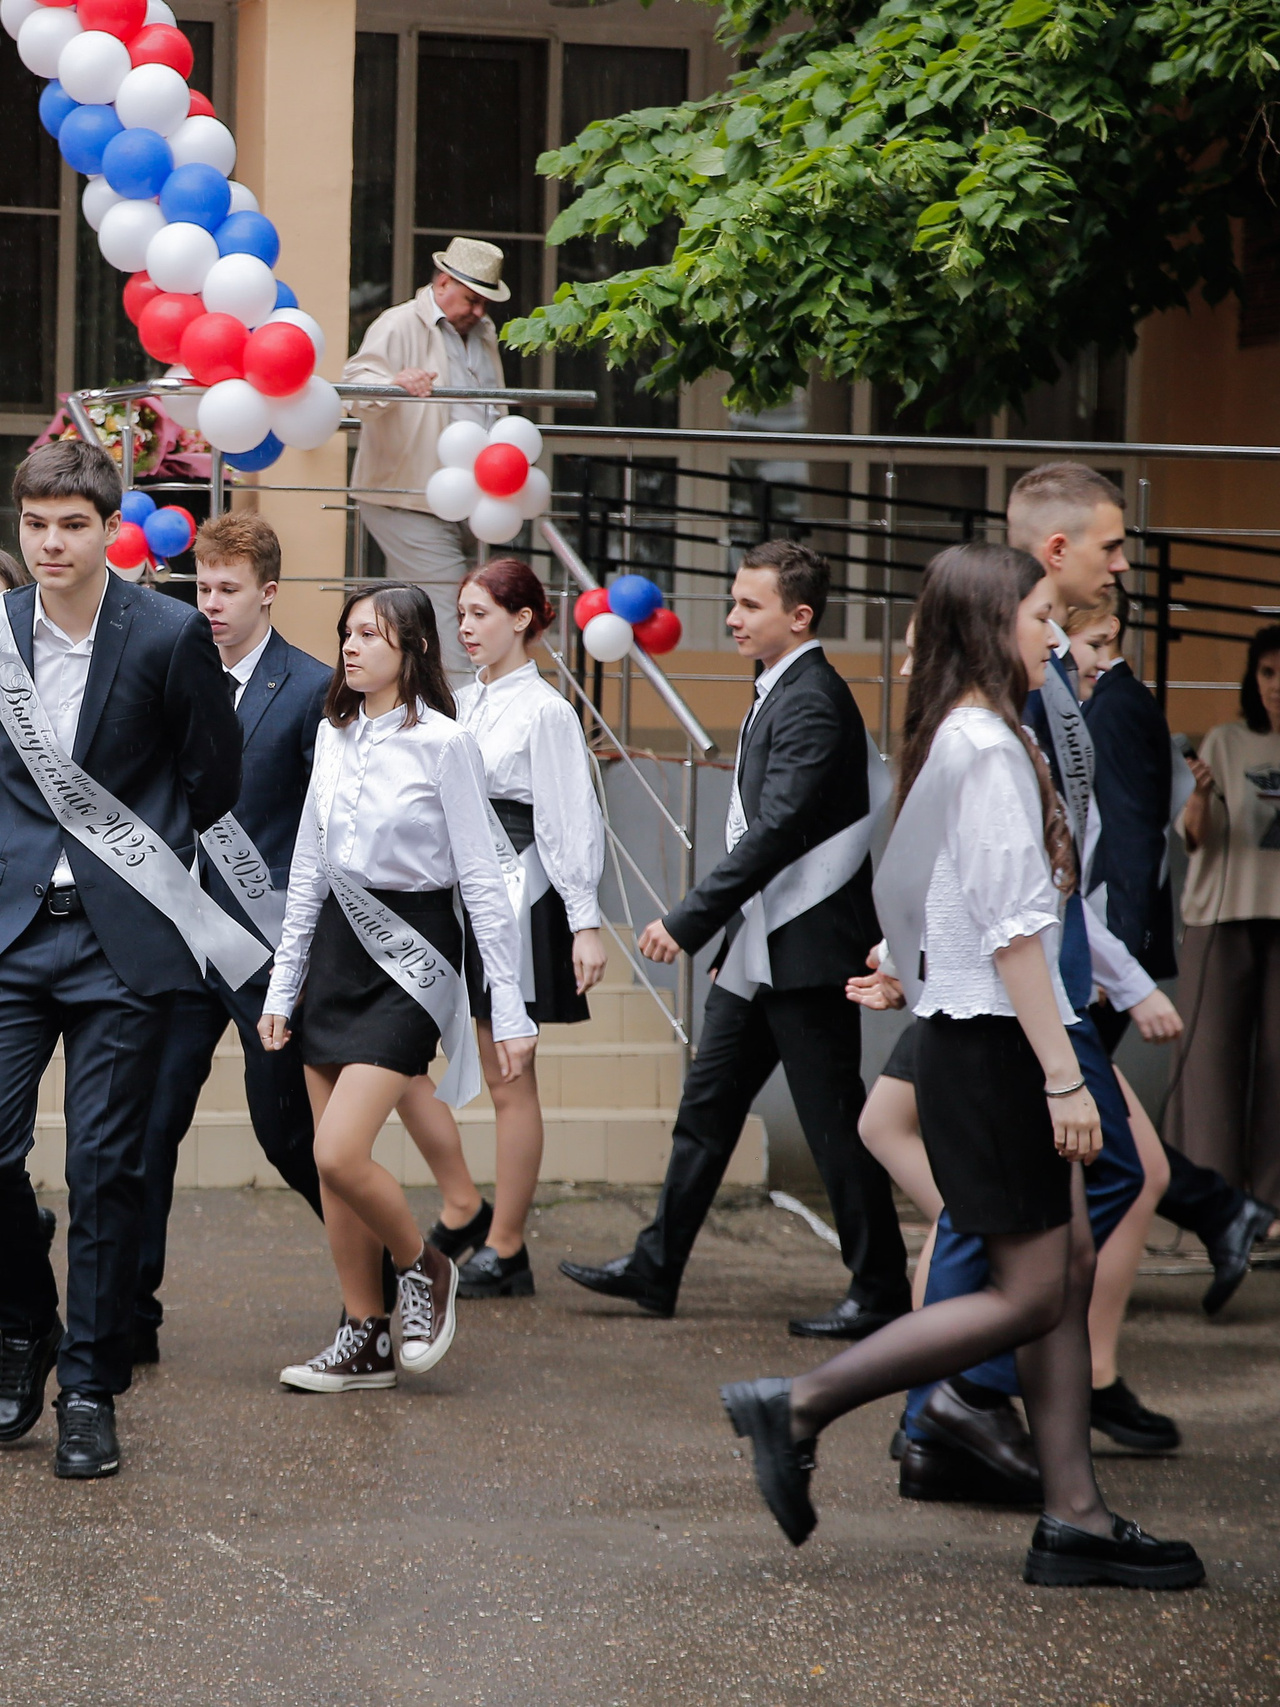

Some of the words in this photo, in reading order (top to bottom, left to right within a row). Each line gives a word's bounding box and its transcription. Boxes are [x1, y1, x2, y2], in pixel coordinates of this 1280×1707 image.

[86, 810, 160, 868] 2023
[222, 849, 276, 899] 2023
[384, 938, 447, 989] 2023
